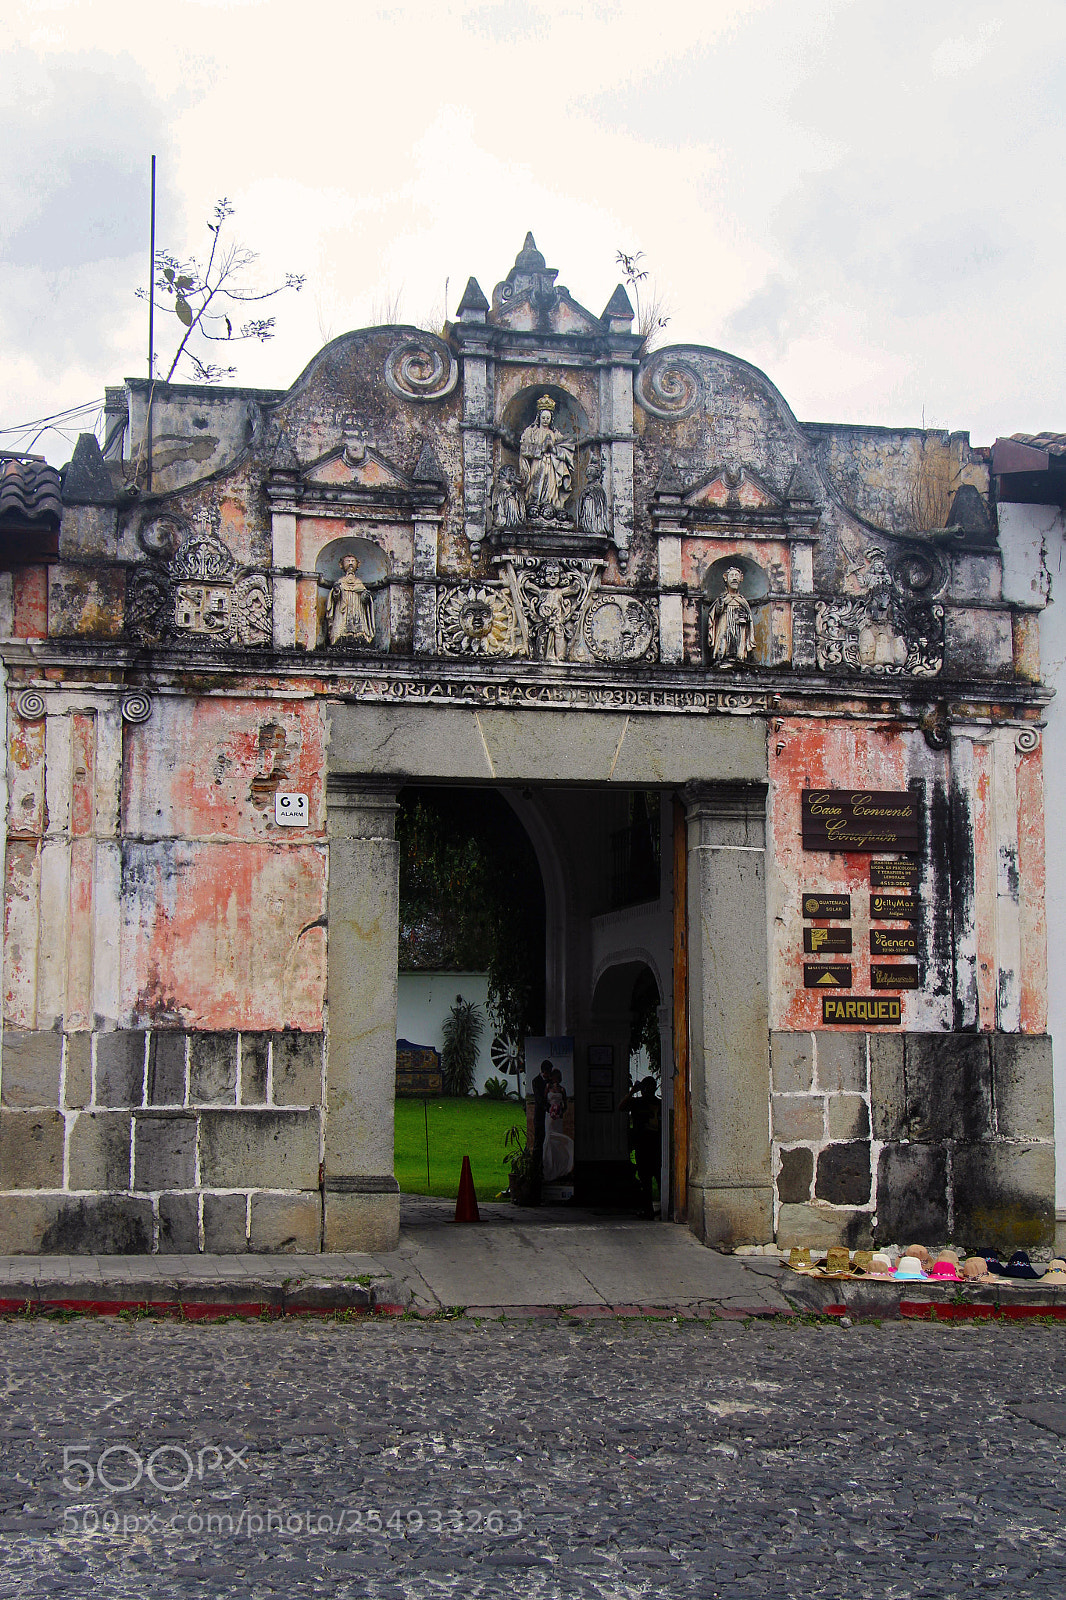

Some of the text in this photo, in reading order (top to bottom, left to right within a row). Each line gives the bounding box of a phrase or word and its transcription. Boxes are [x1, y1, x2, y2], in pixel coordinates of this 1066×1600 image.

[602, 690, 624, 705] 23
[625, 690, 650, 705] DE
[808, 793, 913, 817] Casa Convento
[825, 1001, 900, 1020] PARQUEO
